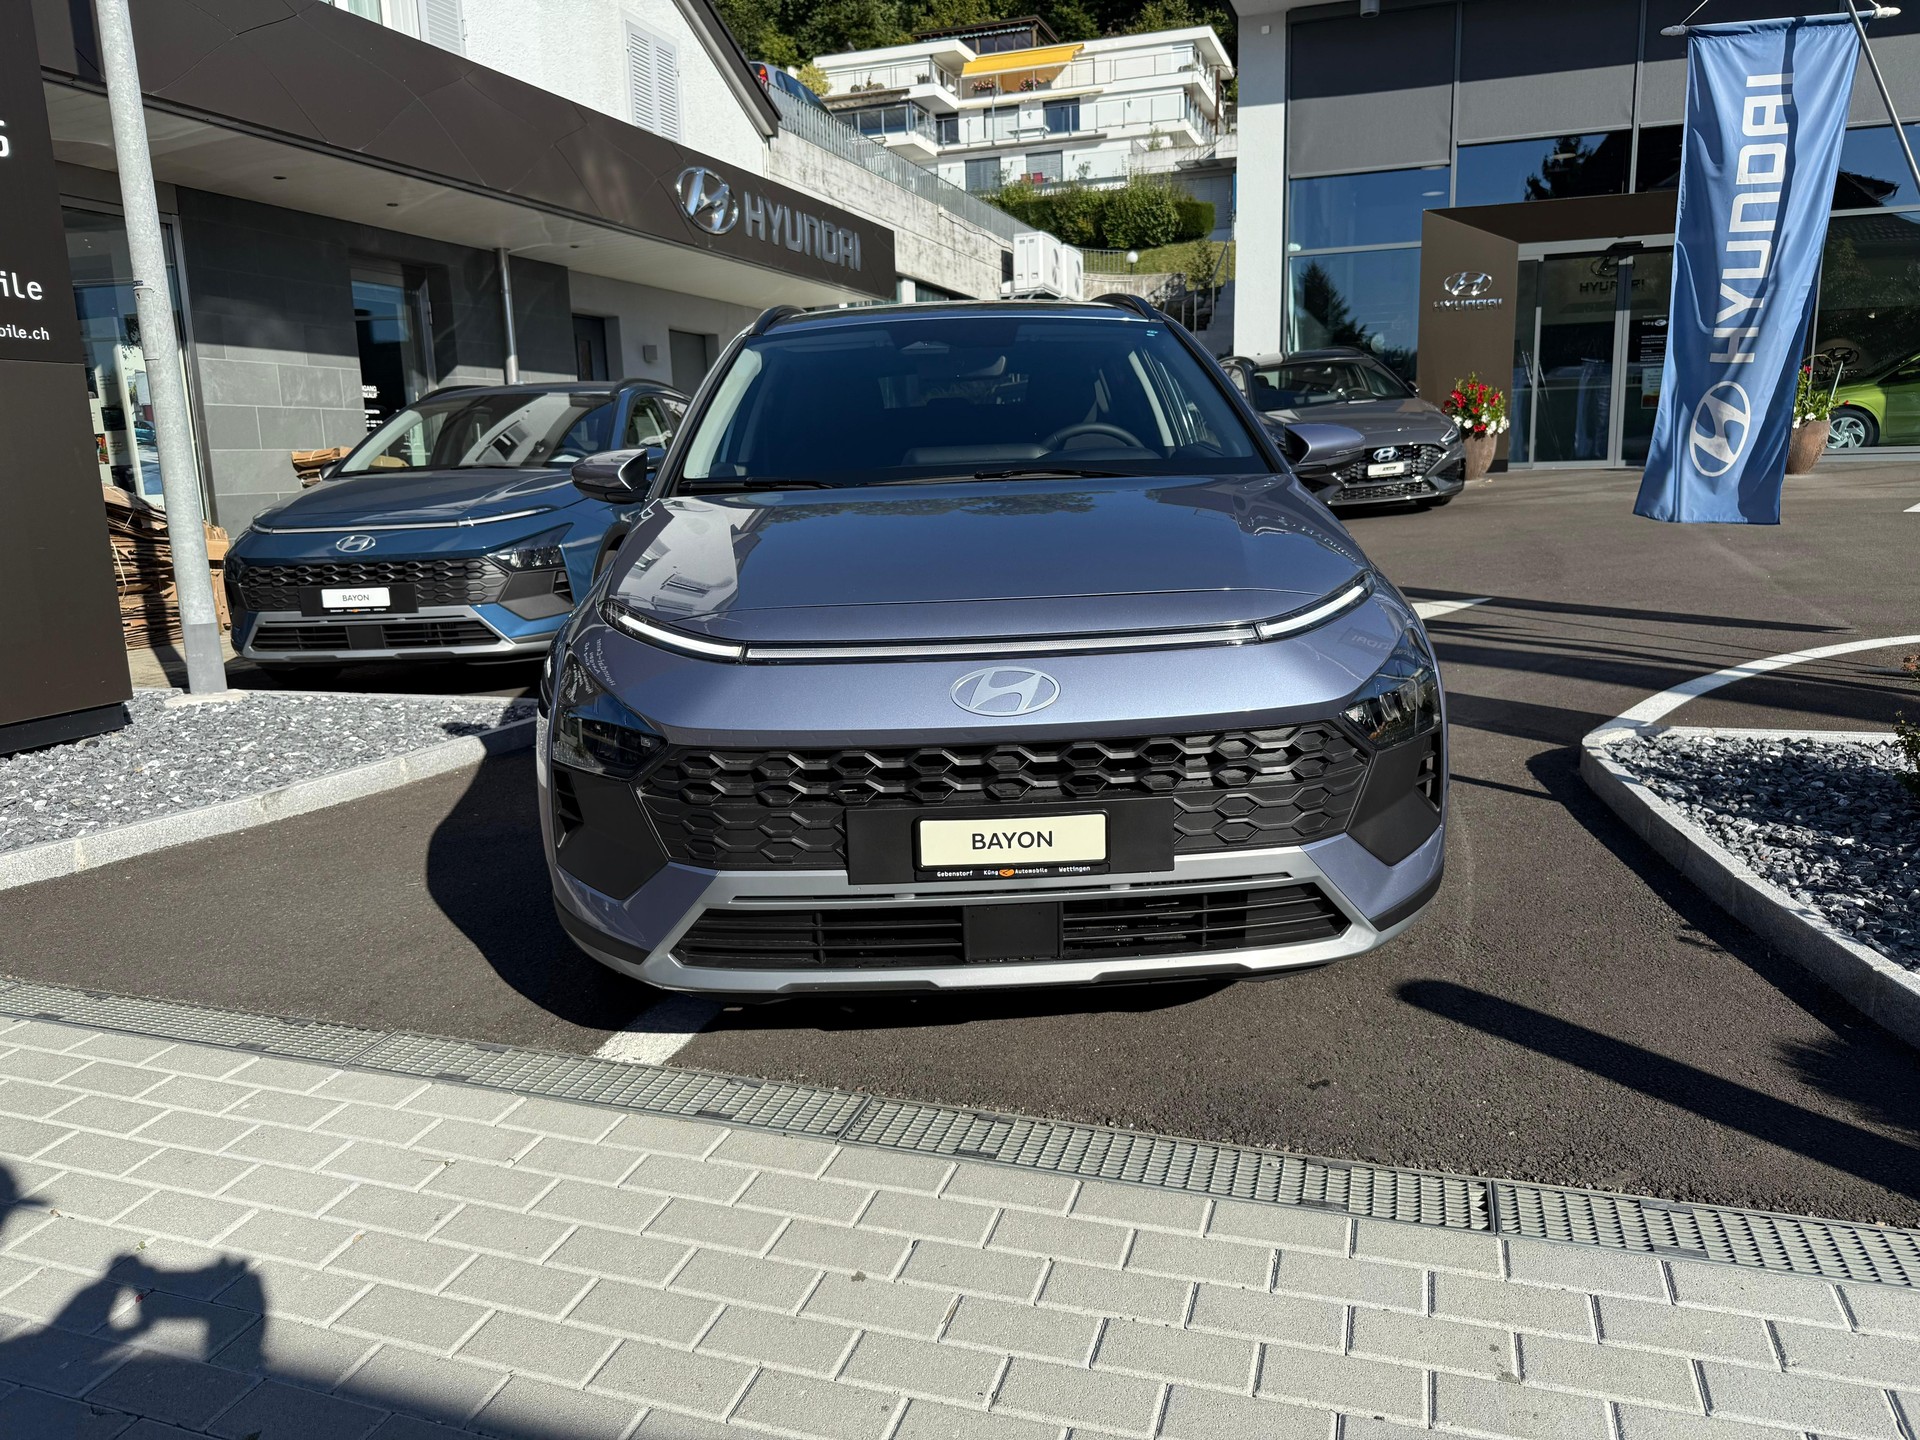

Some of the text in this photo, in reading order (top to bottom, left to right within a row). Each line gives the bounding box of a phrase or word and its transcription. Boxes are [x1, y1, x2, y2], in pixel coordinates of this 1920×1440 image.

[1709, 73, 1794, 363] HYUNDAI
[744, 191, 861, 271] HYUNDAI
[342, 594, 370, 602] BAYON
[971, 830, 1054, 850] BAYON
[1058, 865, 1091, 873] Wettingen
